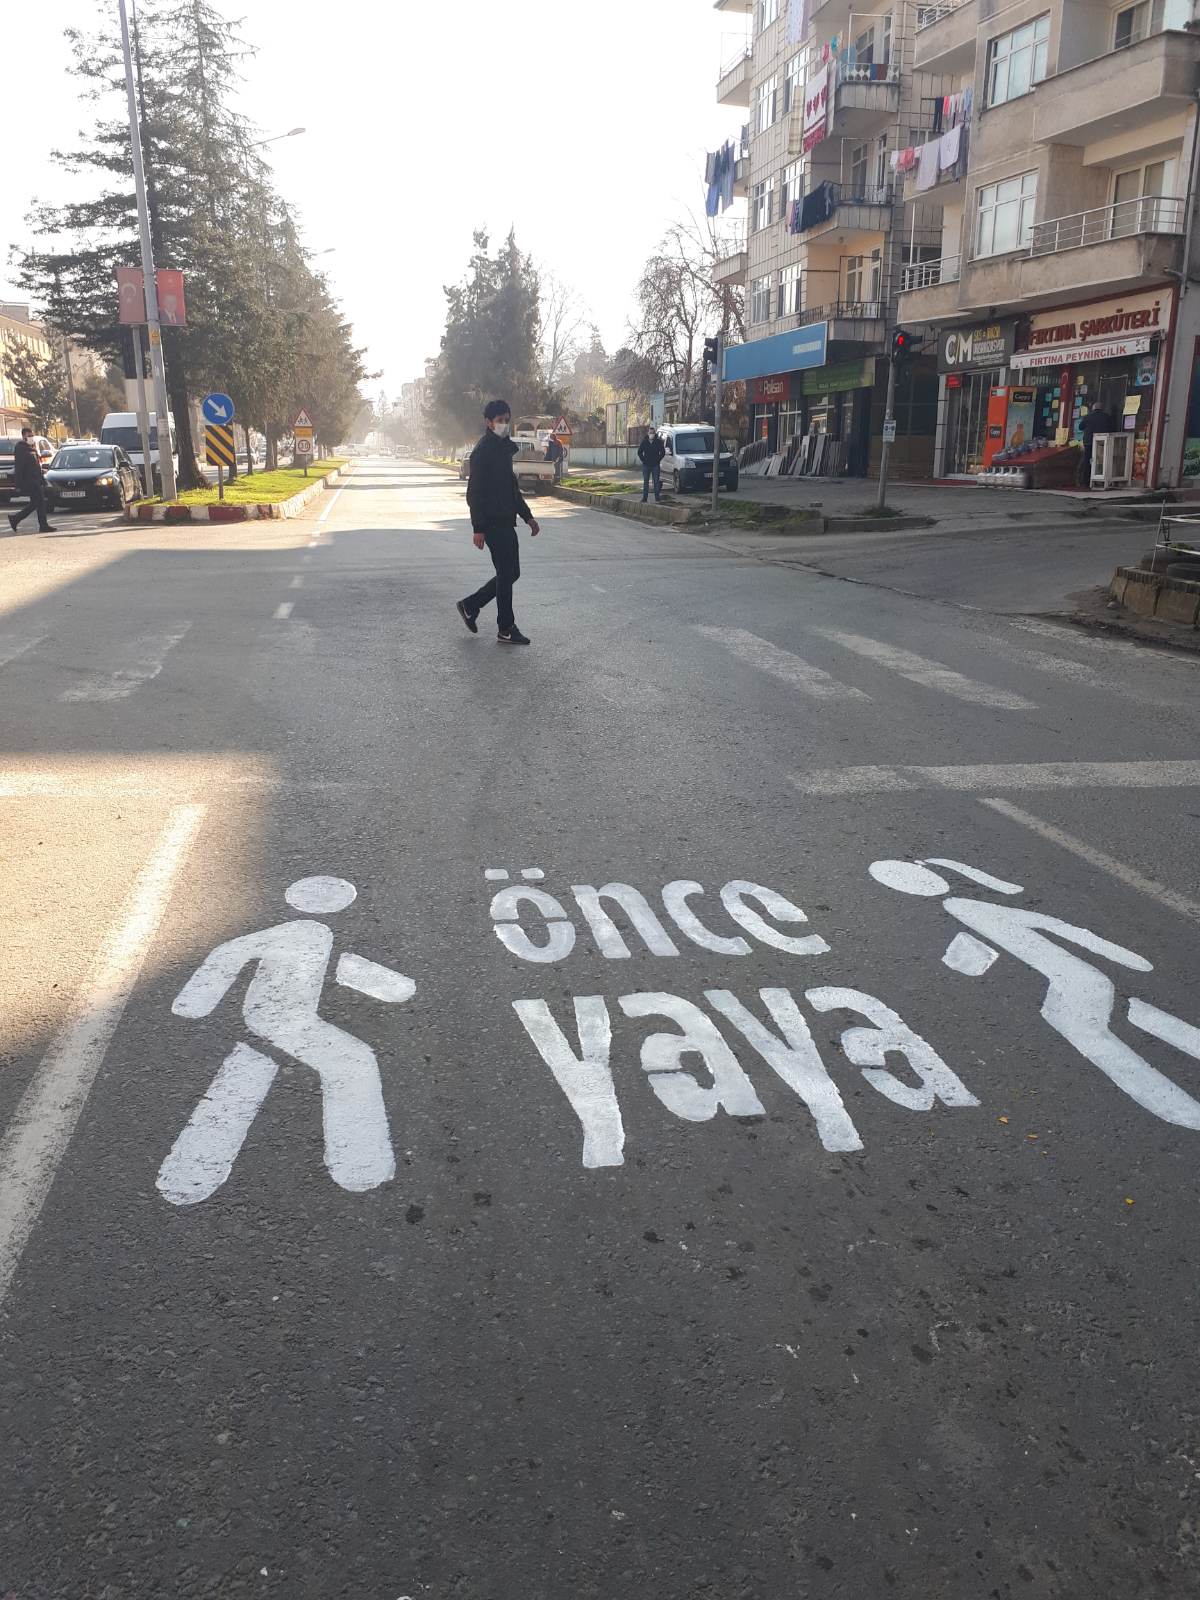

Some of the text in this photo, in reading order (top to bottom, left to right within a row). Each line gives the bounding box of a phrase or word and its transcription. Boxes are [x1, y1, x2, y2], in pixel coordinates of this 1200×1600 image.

[1079, 301, 1160, 341] ŞARKÜTERİ
[1029, 345, 1127, 366] FIRTINA PEYNİRCİLİK
[484, 867, 831, 963] önce
[512, 986, 981, 1168] yaya
